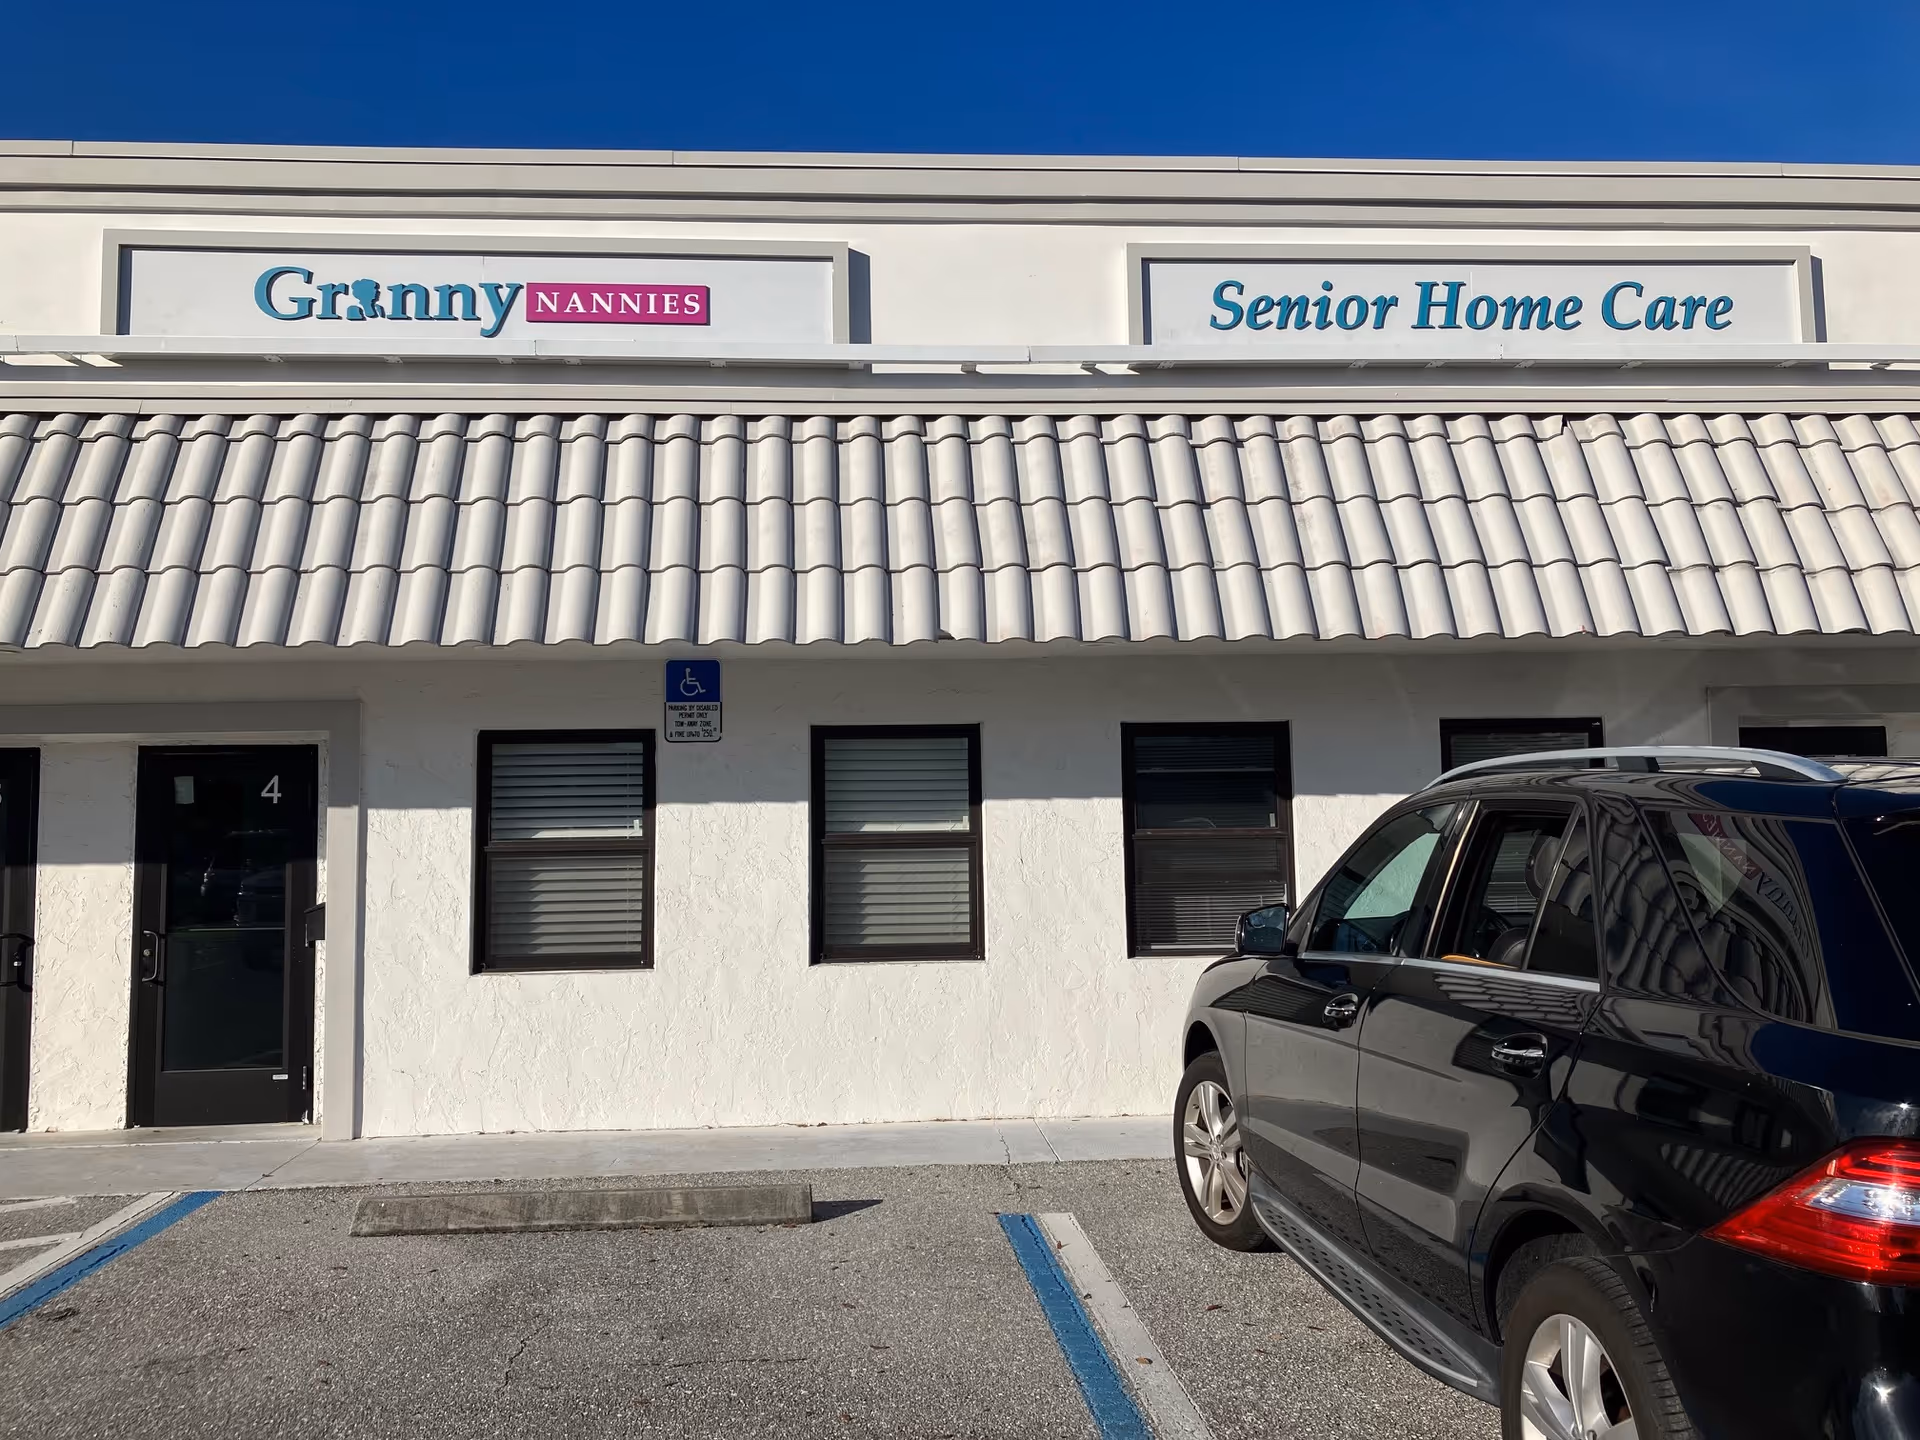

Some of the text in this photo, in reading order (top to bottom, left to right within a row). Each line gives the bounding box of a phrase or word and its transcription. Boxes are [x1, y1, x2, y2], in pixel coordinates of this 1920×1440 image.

[535, 291, 701, 315] NANNIES
[1208, 279, 1734, 331] Senior Home Care
[260, 774, 282, 804] 4
